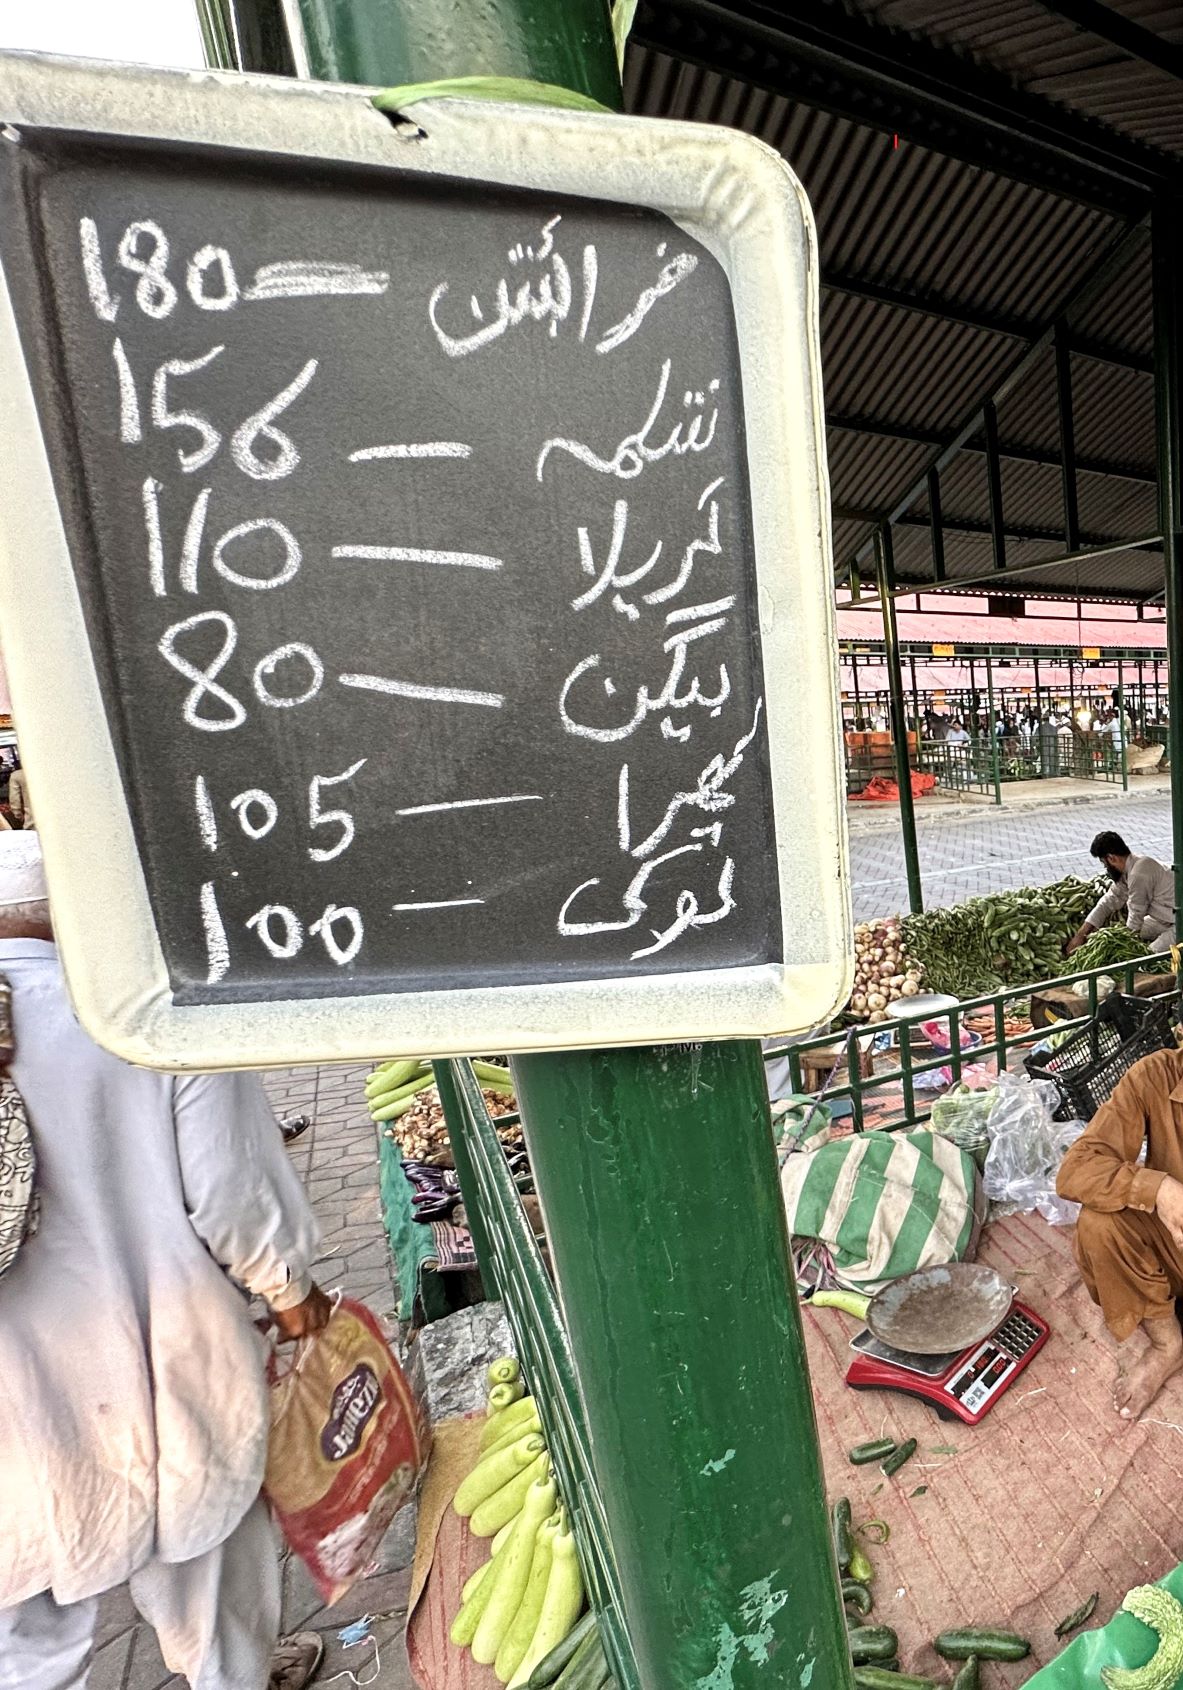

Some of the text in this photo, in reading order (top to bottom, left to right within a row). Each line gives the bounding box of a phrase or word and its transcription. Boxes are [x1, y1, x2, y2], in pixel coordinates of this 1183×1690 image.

[80, 216, 240, 322] 180
[111, 336, 320, 481] 156
[144, 477, 303, 598] 110
[158, 610, 325, 732] 80
[193, 758, 368, 862] 105
[200, 880, 365, 985] 100
